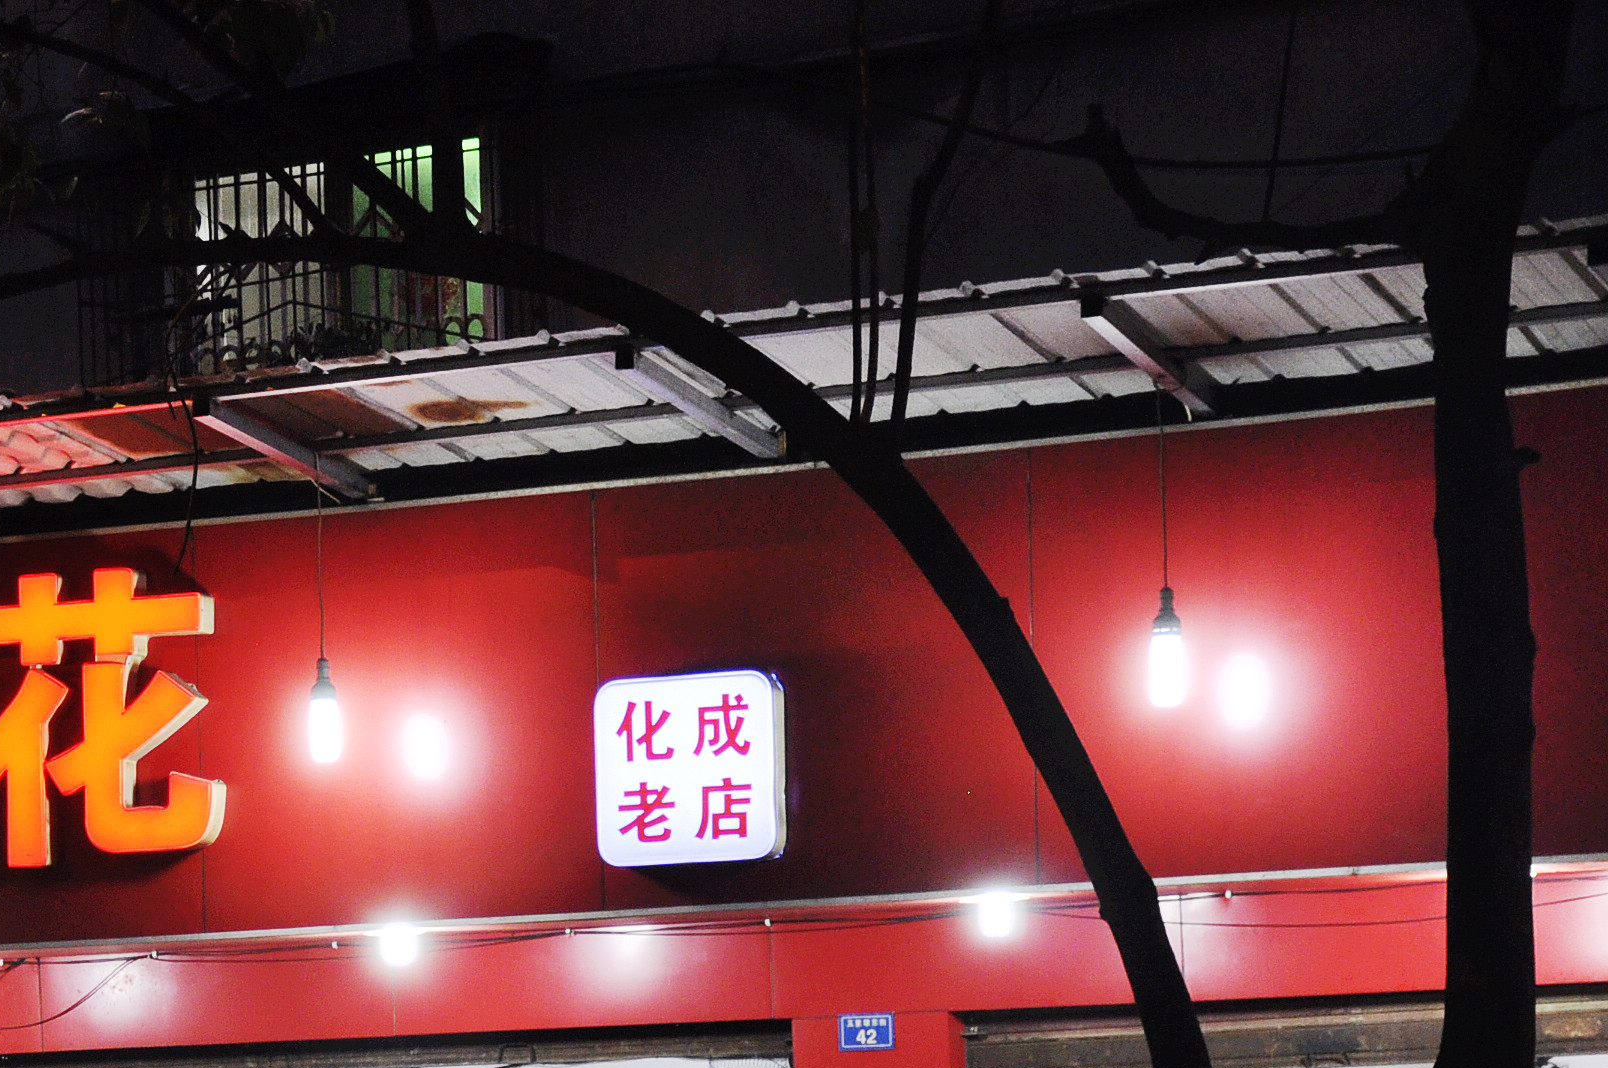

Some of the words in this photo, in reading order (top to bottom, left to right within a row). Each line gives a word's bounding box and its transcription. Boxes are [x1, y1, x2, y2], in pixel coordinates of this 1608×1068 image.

[616, 693, 751, 762] 化成
[618, 777, 752, 843] 老店
[856, 1028, 877, 1044] 42
